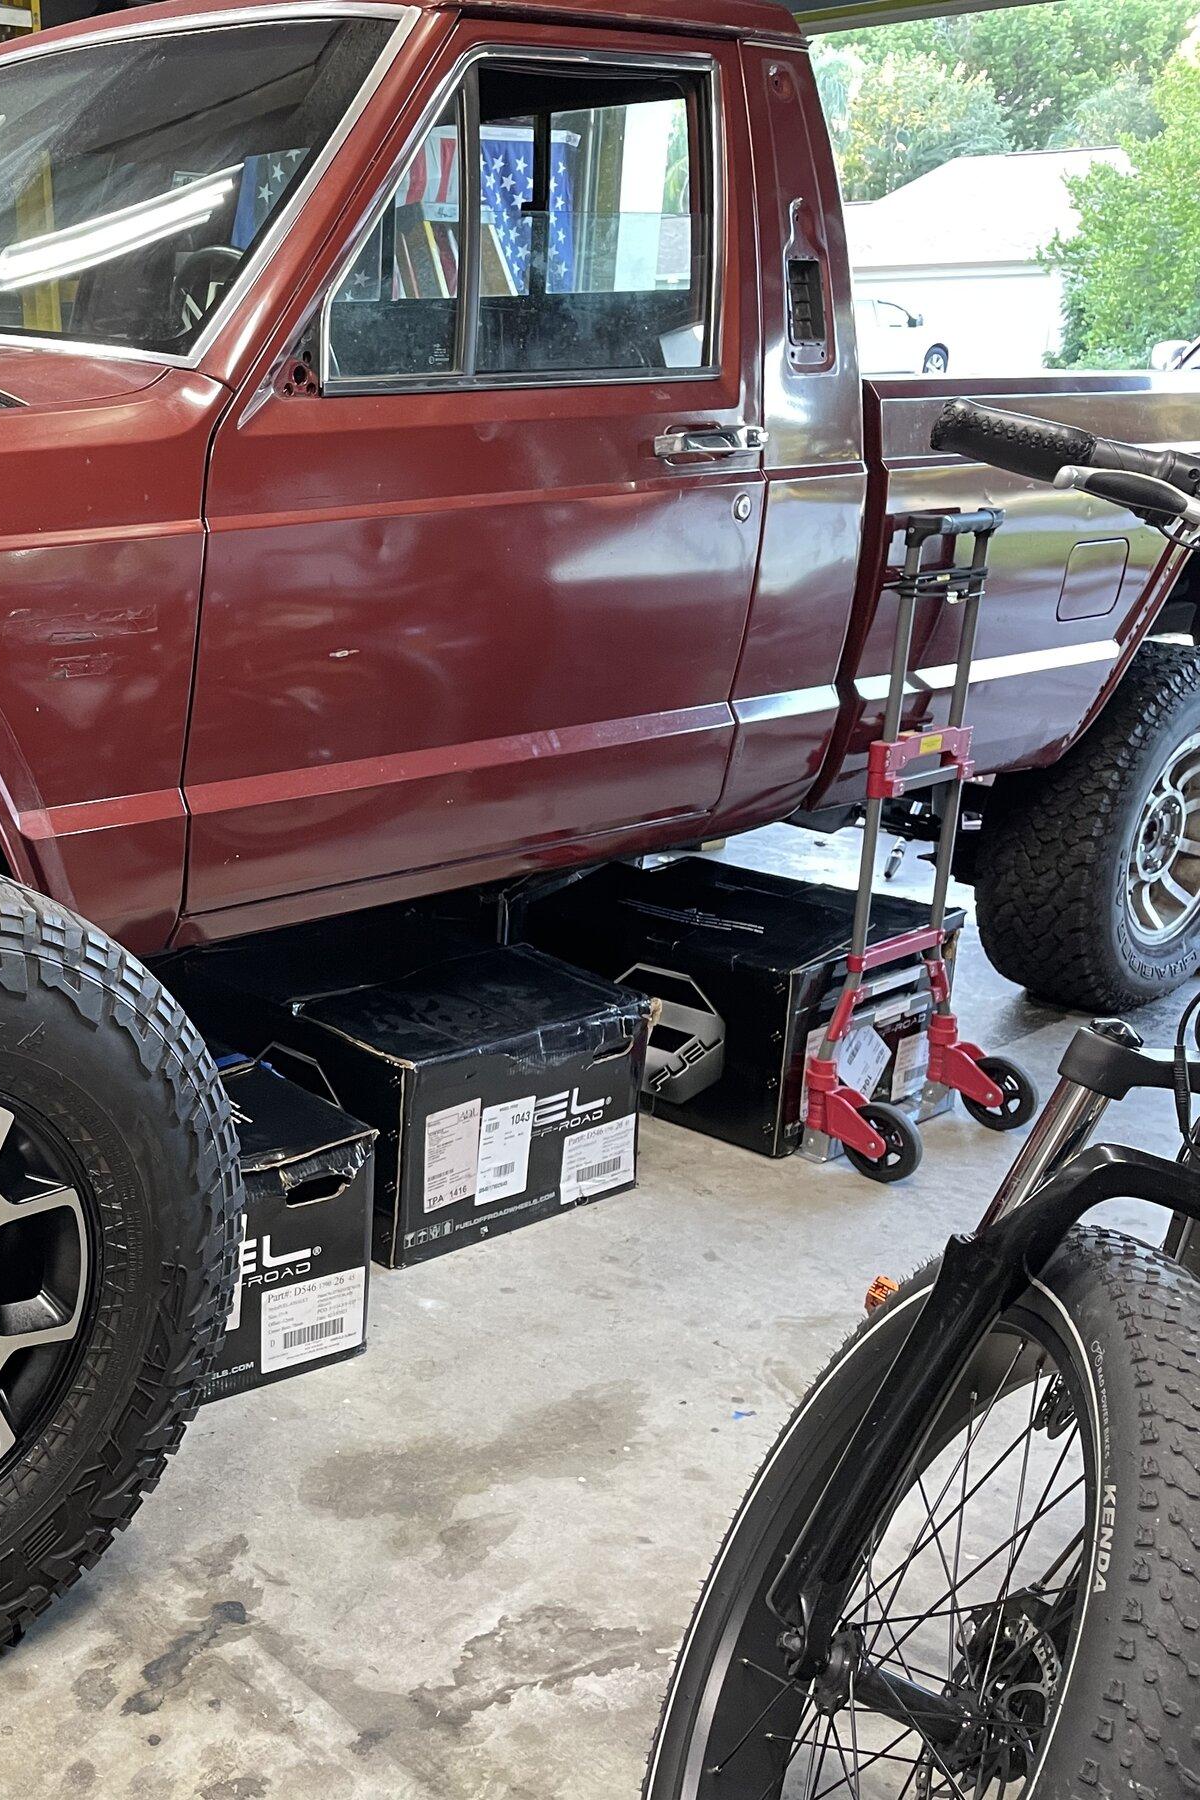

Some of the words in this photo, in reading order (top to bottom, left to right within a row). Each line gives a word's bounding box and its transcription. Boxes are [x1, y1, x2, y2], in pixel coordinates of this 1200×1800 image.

[648, 1037, 725, 1092] FUEL
[511, 1111, 531, 1125] 1043
[427, 1195, 444, 1207] TPA
[450, 1185, 467, 1198] 1416
[267, 1290, 292, 1303] Part#:
[294, 1283, 317, 1296] D546
[334, 1276, 345, 1285] 26
[1101, 1387, 1109, 1425] POWER
[1093, 1484, 1117, 1593] KENDA
